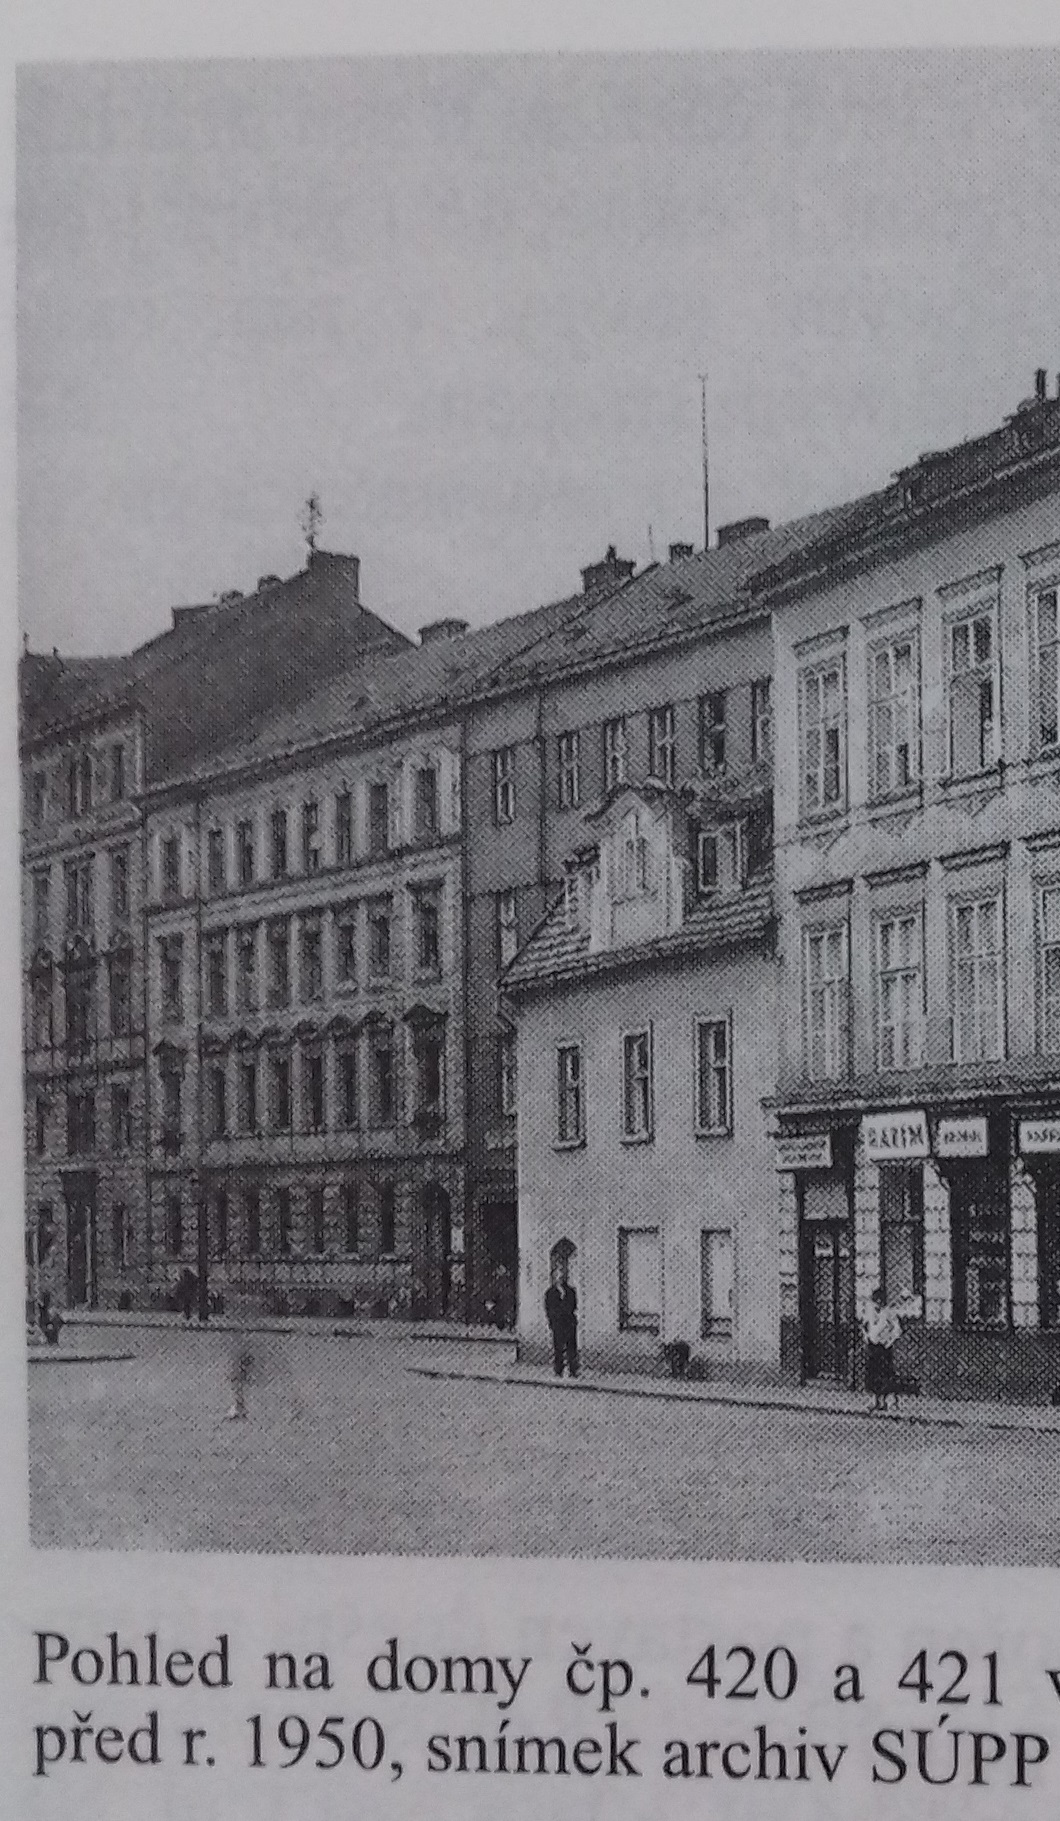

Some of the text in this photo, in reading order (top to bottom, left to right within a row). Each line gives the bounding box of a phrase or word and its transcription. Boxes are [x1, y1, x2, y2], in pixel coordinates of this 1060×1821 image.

[33, 1631, 234, 1689] Pohled
[264, 1652, 335, 1691] na
[367, 1637, 533, 1711] domy
[565, 1642, 650, 1713] čp.
[685, 1644, 801, 1701] 420
[833, 1663, 865, 1704] a
[897, 1648, 1003, 1706] 421
[33, 1710, 1050, 1788] před r. 1950, snímek archiv SÚPP
